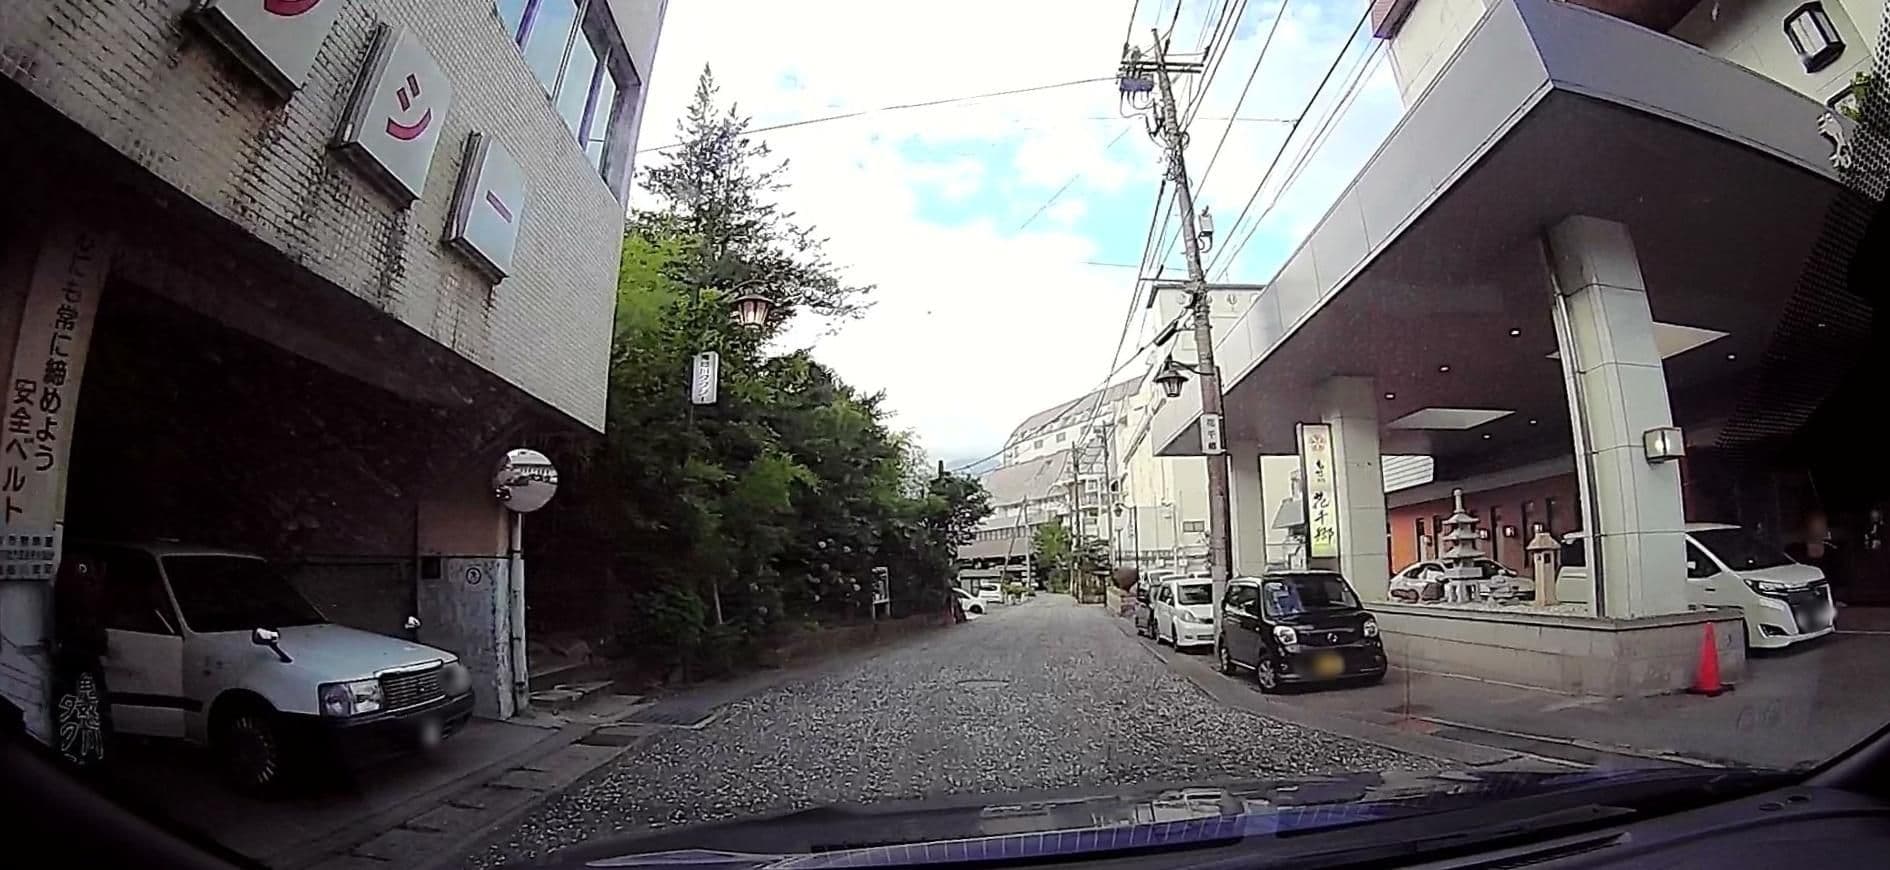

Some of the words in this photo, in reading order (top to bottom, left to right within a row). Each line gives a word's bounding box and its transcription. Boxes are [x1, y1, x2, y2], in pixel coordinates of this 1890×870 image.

[263, 0, 513, 224] シー
[2, 378, 37, 525] 安全ベルト
